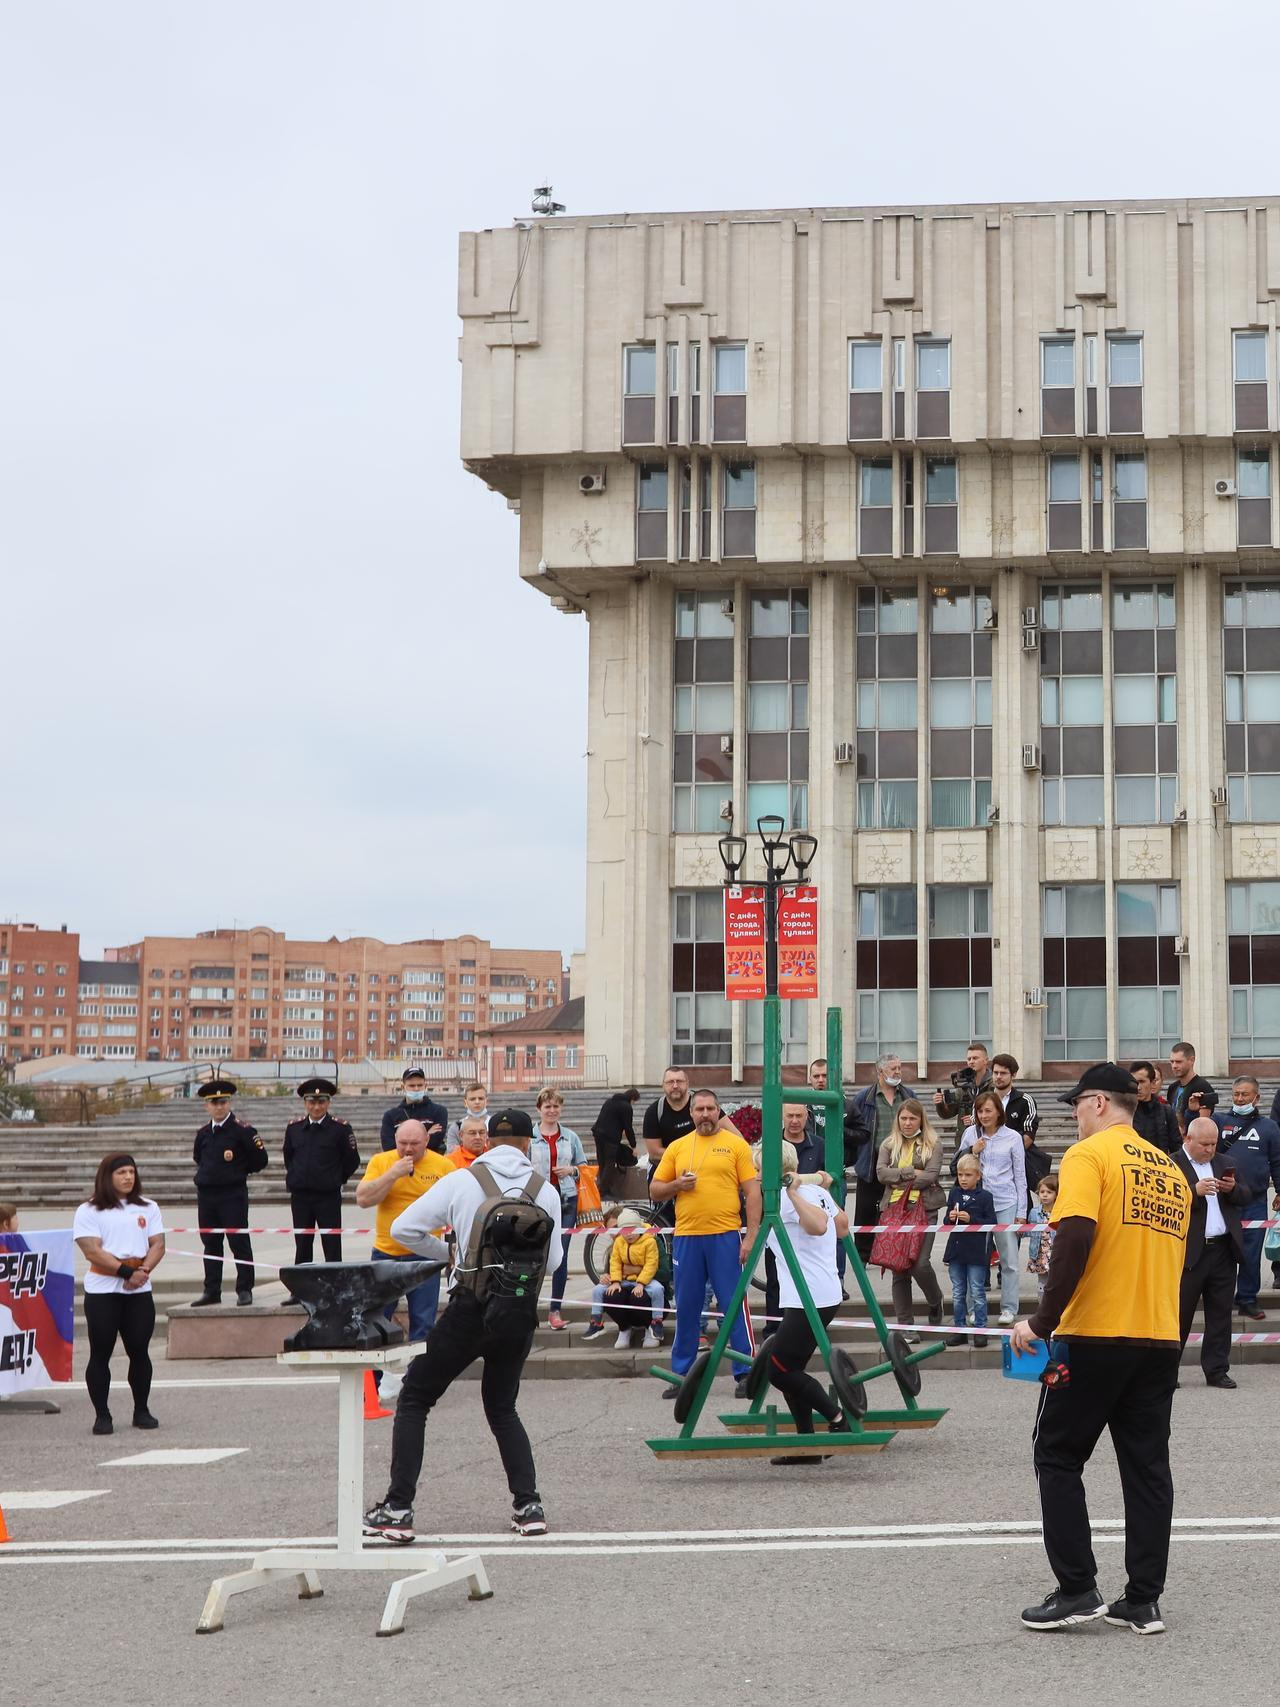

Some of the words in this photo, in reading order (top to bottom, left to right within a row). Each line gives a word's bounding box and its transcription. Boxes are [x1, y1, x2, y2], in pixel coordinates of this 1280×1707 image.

[737, 912, 758, 920] днём
[790, 911, 811, 919] днём
[729, 921, 760, 929] города,
[783, 921, 813, 929] города,
[729, 930, 761, 938] туляки!
[783, 929, 814, 938] туляки!
